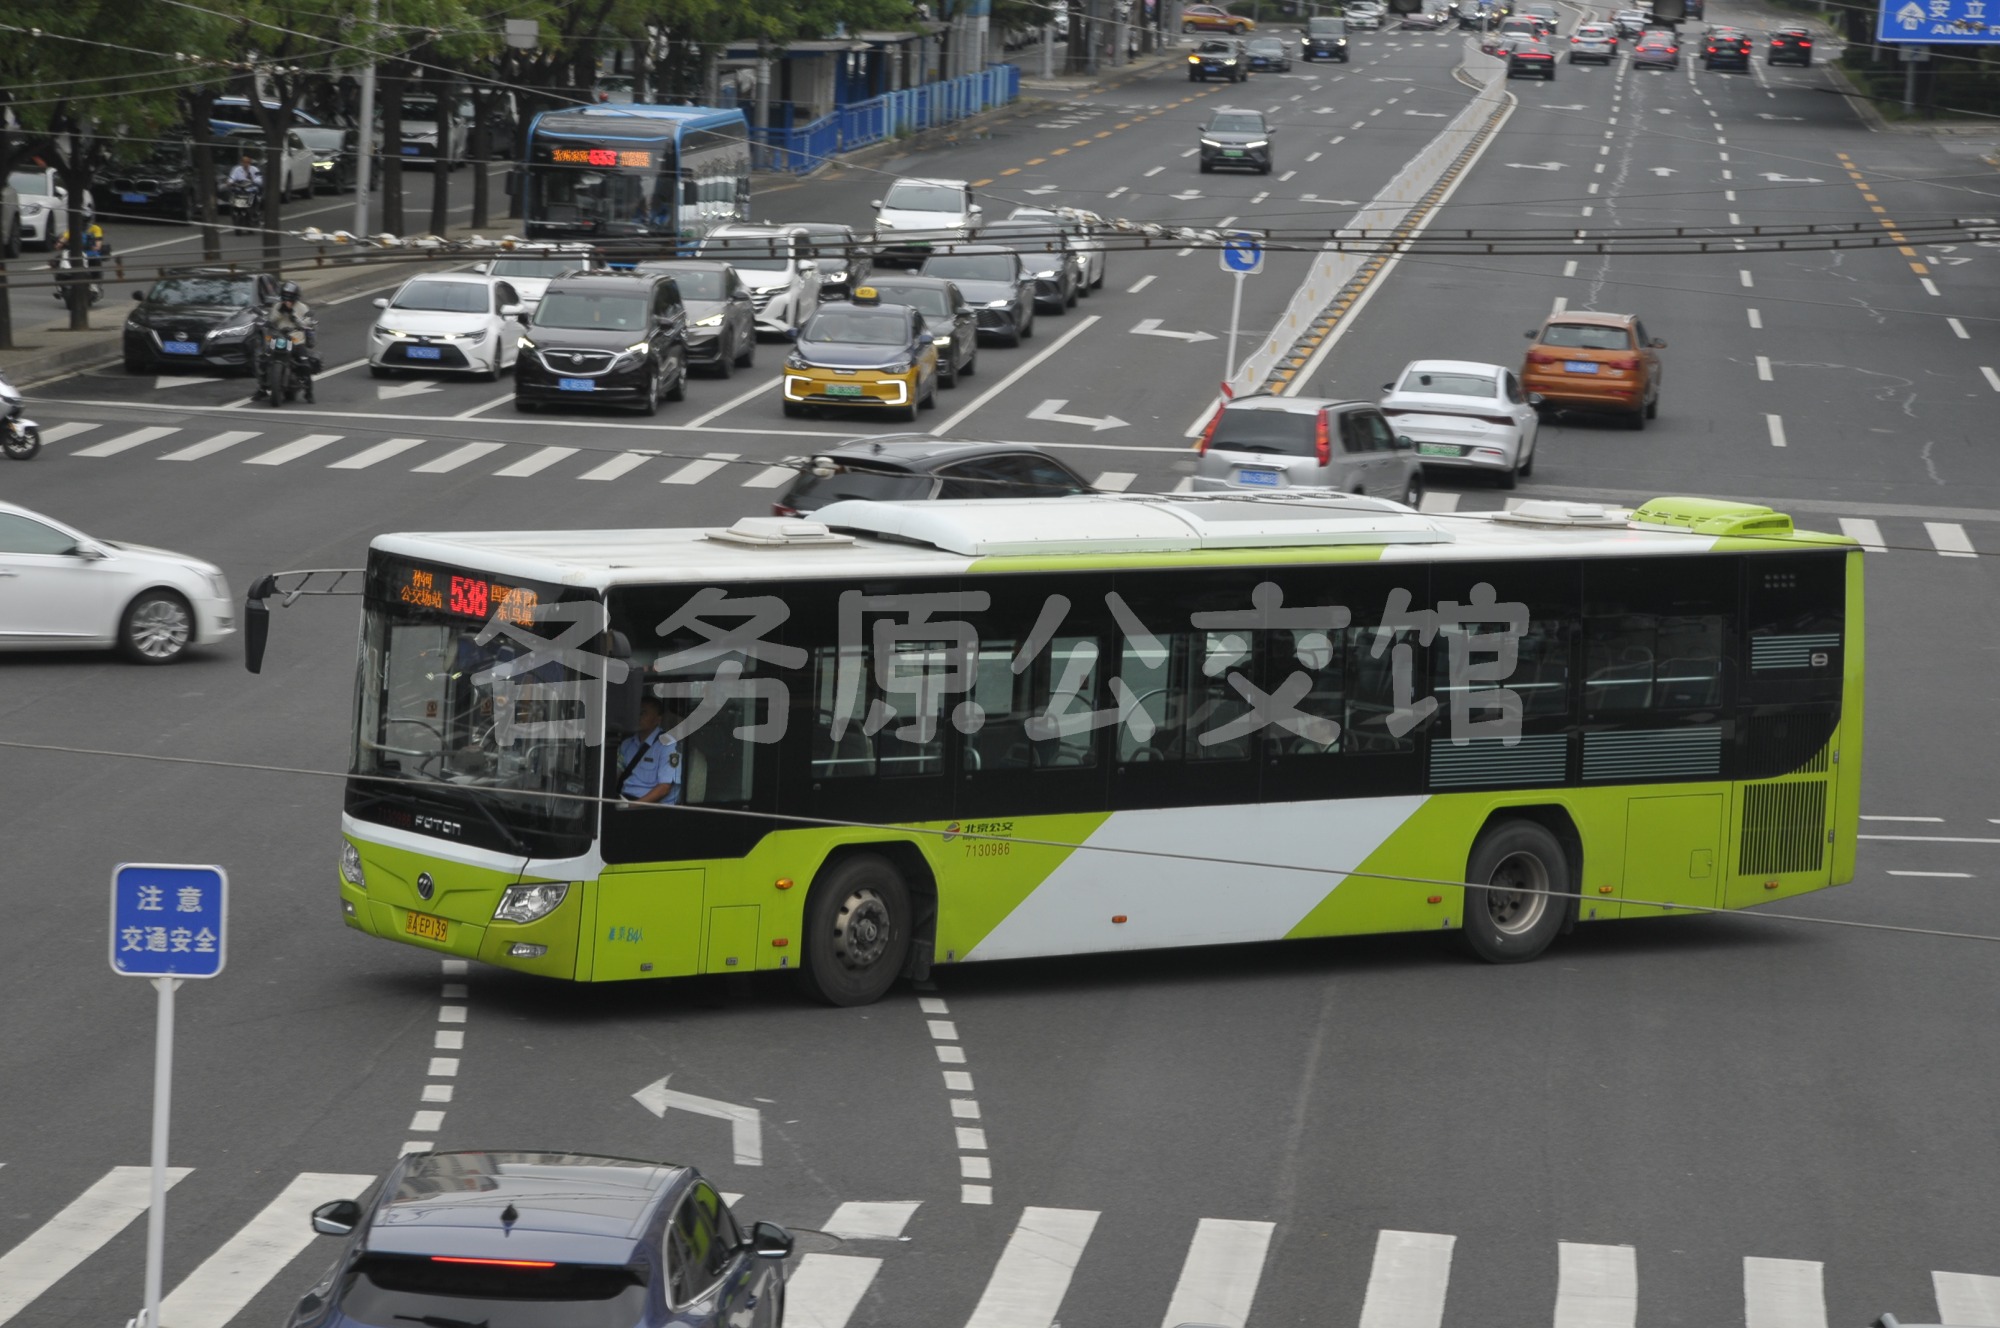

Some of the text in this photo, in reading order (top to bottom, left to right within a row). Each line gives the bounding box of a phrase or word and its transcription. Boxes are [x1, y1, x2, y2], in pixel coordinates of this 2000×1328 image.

[400, 584, 443, 609] 公交场站
[450, 575, 488, 617] 538
[415, 814, 461, 836] FOTON
[964, 822, 1014, 833] 北京公交
[965, 843, 1010, 857] 7130986
[137, 885, 203, 912] 注意
[120, 925, 217, 953] 交通安全
